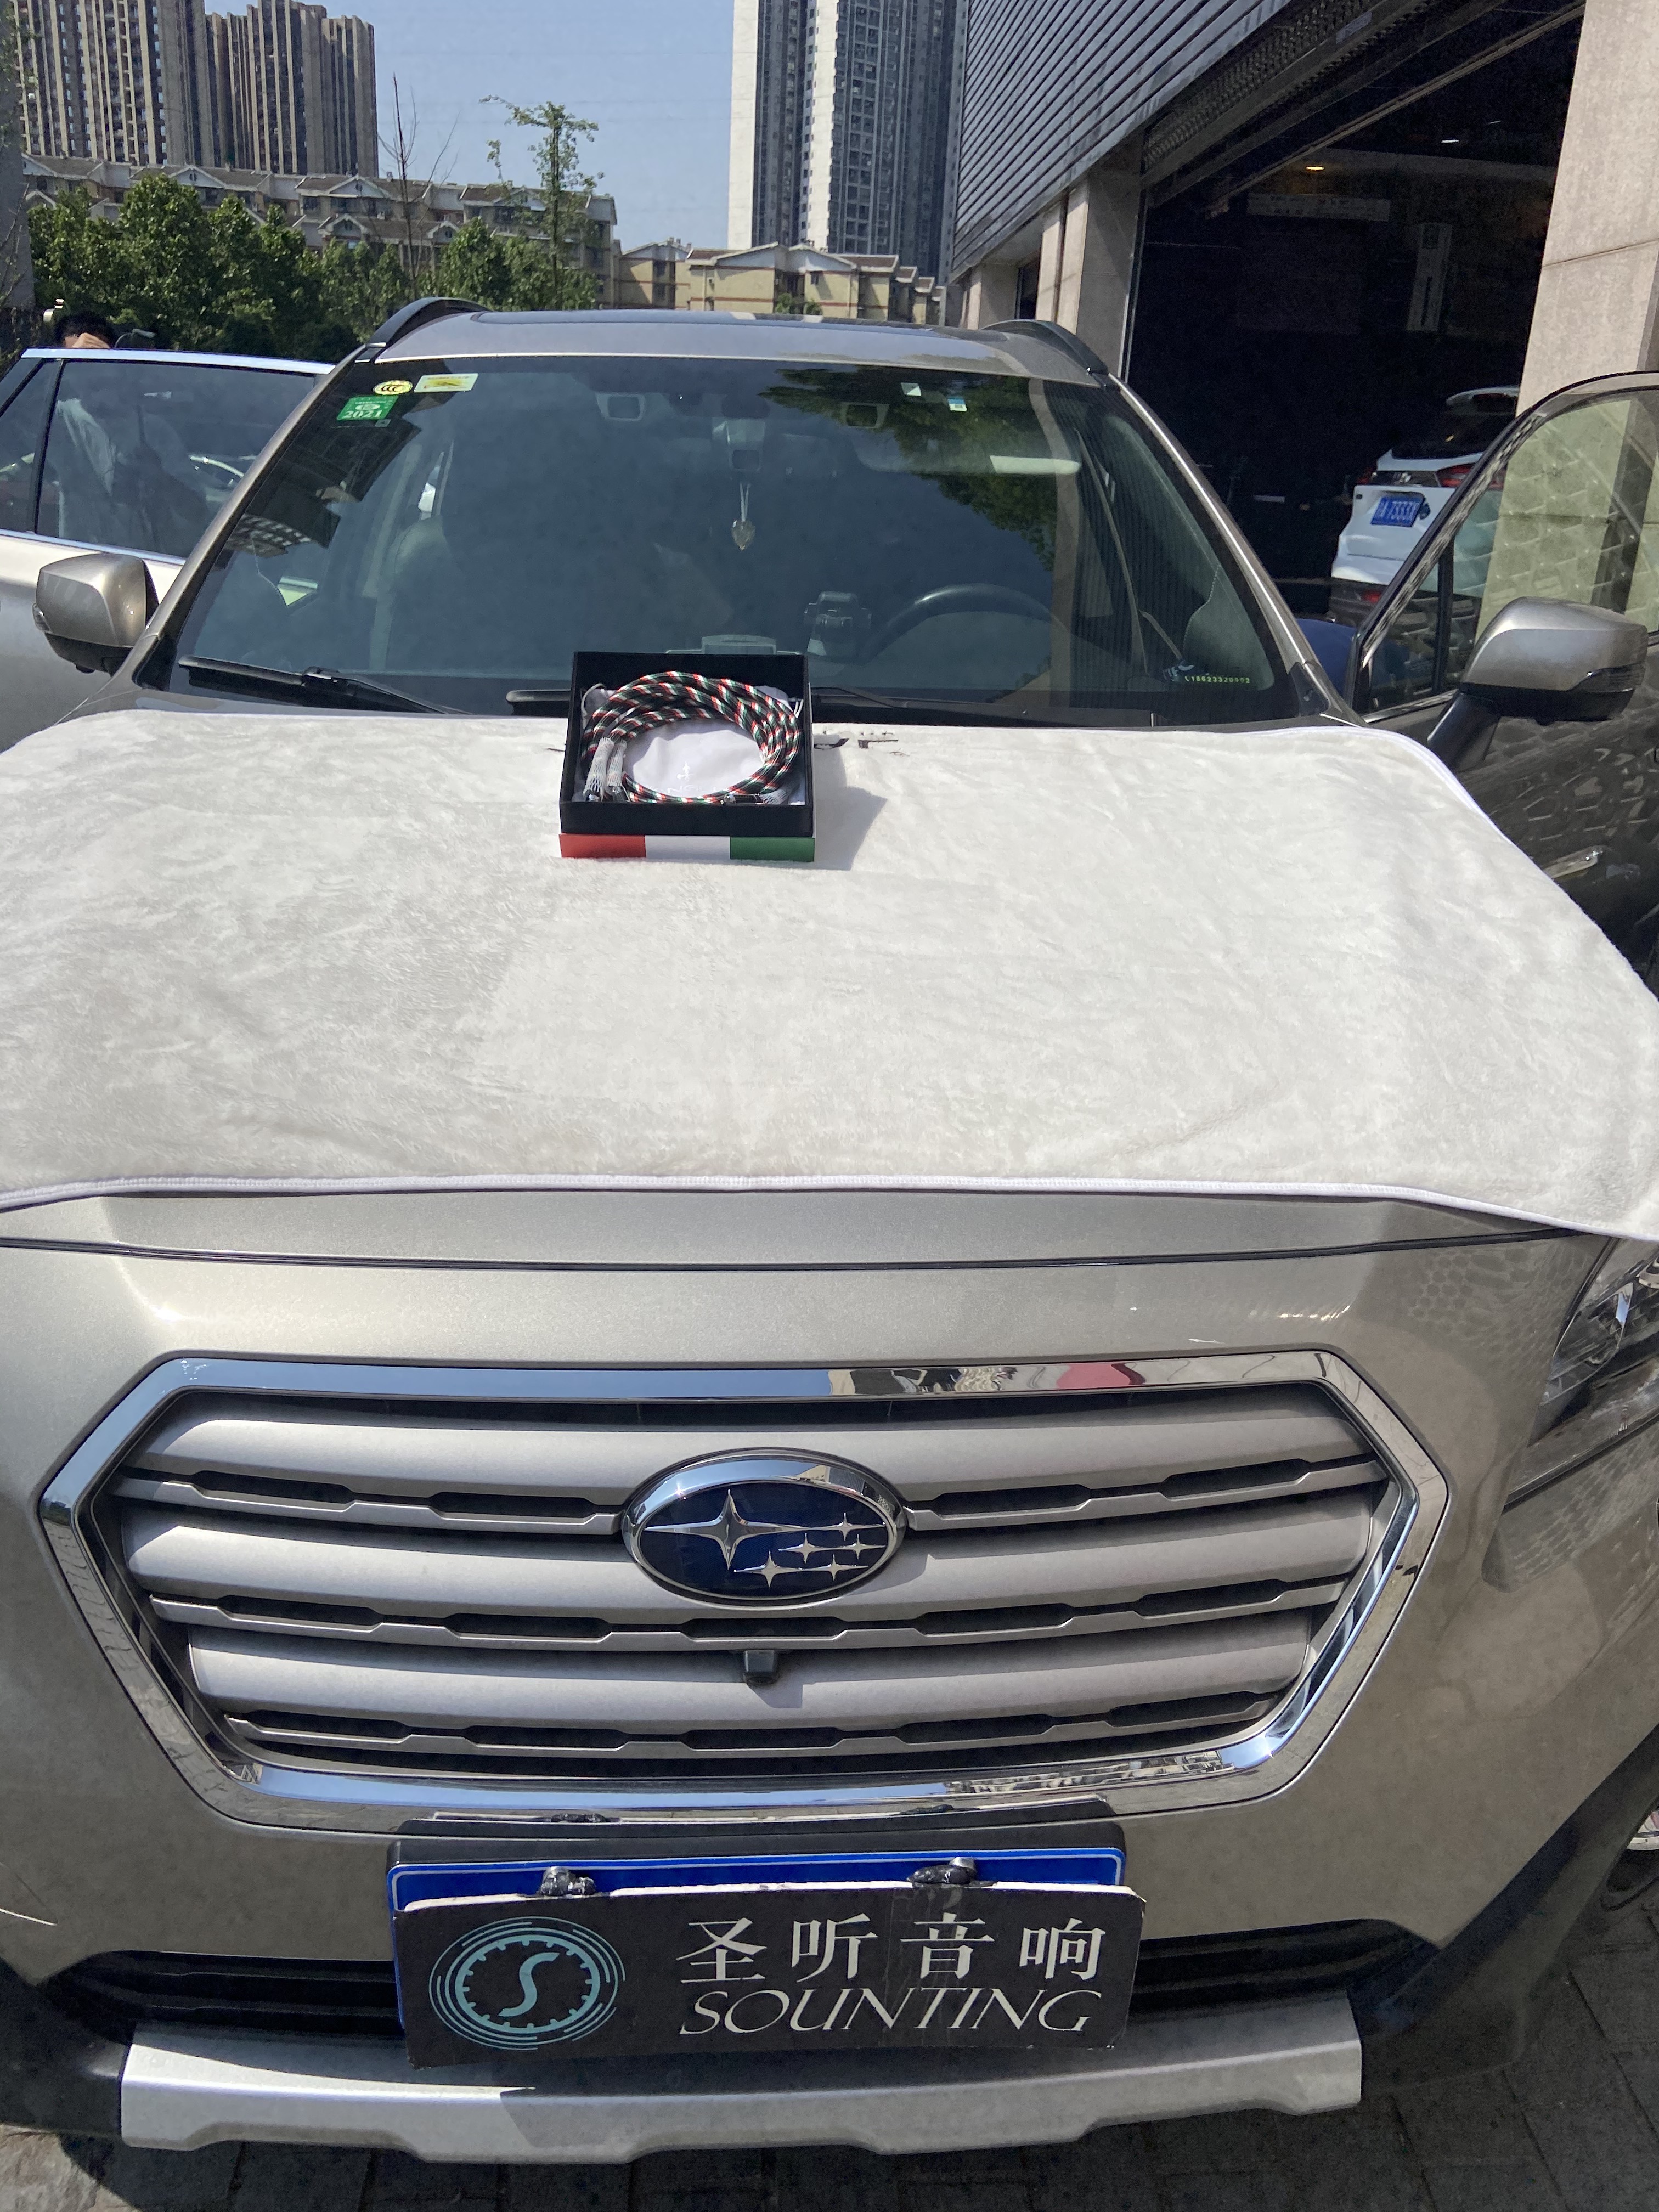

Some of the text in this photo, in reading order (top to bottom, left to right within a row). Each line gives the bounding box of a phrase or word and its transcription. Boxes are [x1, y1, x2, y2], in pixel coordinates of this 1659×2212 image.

[342, 410, 382, 419] 2021
[675, 1912, 1106, 1983] 圣听音响
[679, 1987, 1102, 2035] SOUNTING
